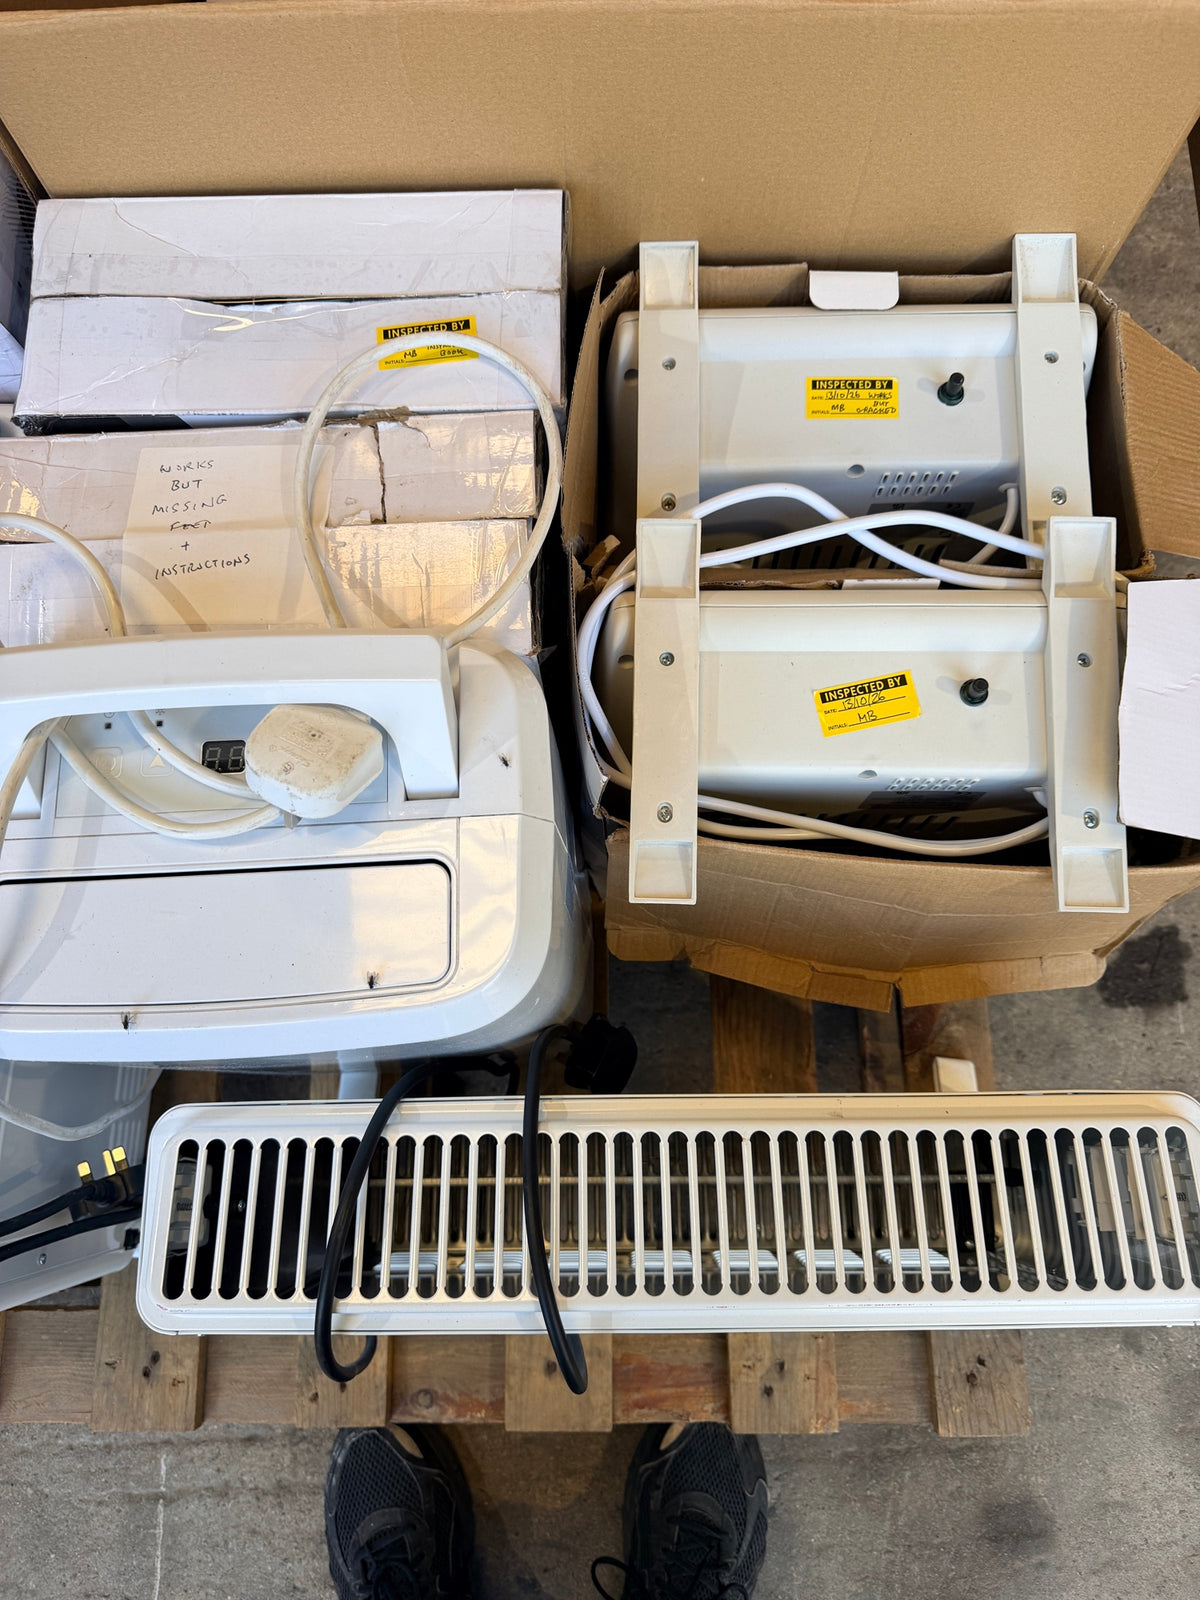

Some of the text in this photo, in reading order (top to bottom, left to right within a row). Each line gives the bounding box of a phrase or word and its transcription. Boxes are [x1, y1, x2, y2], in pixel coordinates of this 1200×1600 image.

[388, 320, 465, 339] INSPECTED BY
[403, 349, 418, 359] MB
[815, 380, 889, 389] INSPECTED BY
[825, 389, 861, 400] 13/10/26
[831, 403, 845, 412] MB
[159, 459, 215, 474] WORKS
[170, 479, 203, 492] BUT
[151, 494, 228, 516] MISSING
[154, 553, 251, 581] INSTRUCTIONS
[824, 676, 901, 702] INSPECTED BY
[841, 691, 886, 711] 13/10/26
[857, 709, 878, 723] MB
